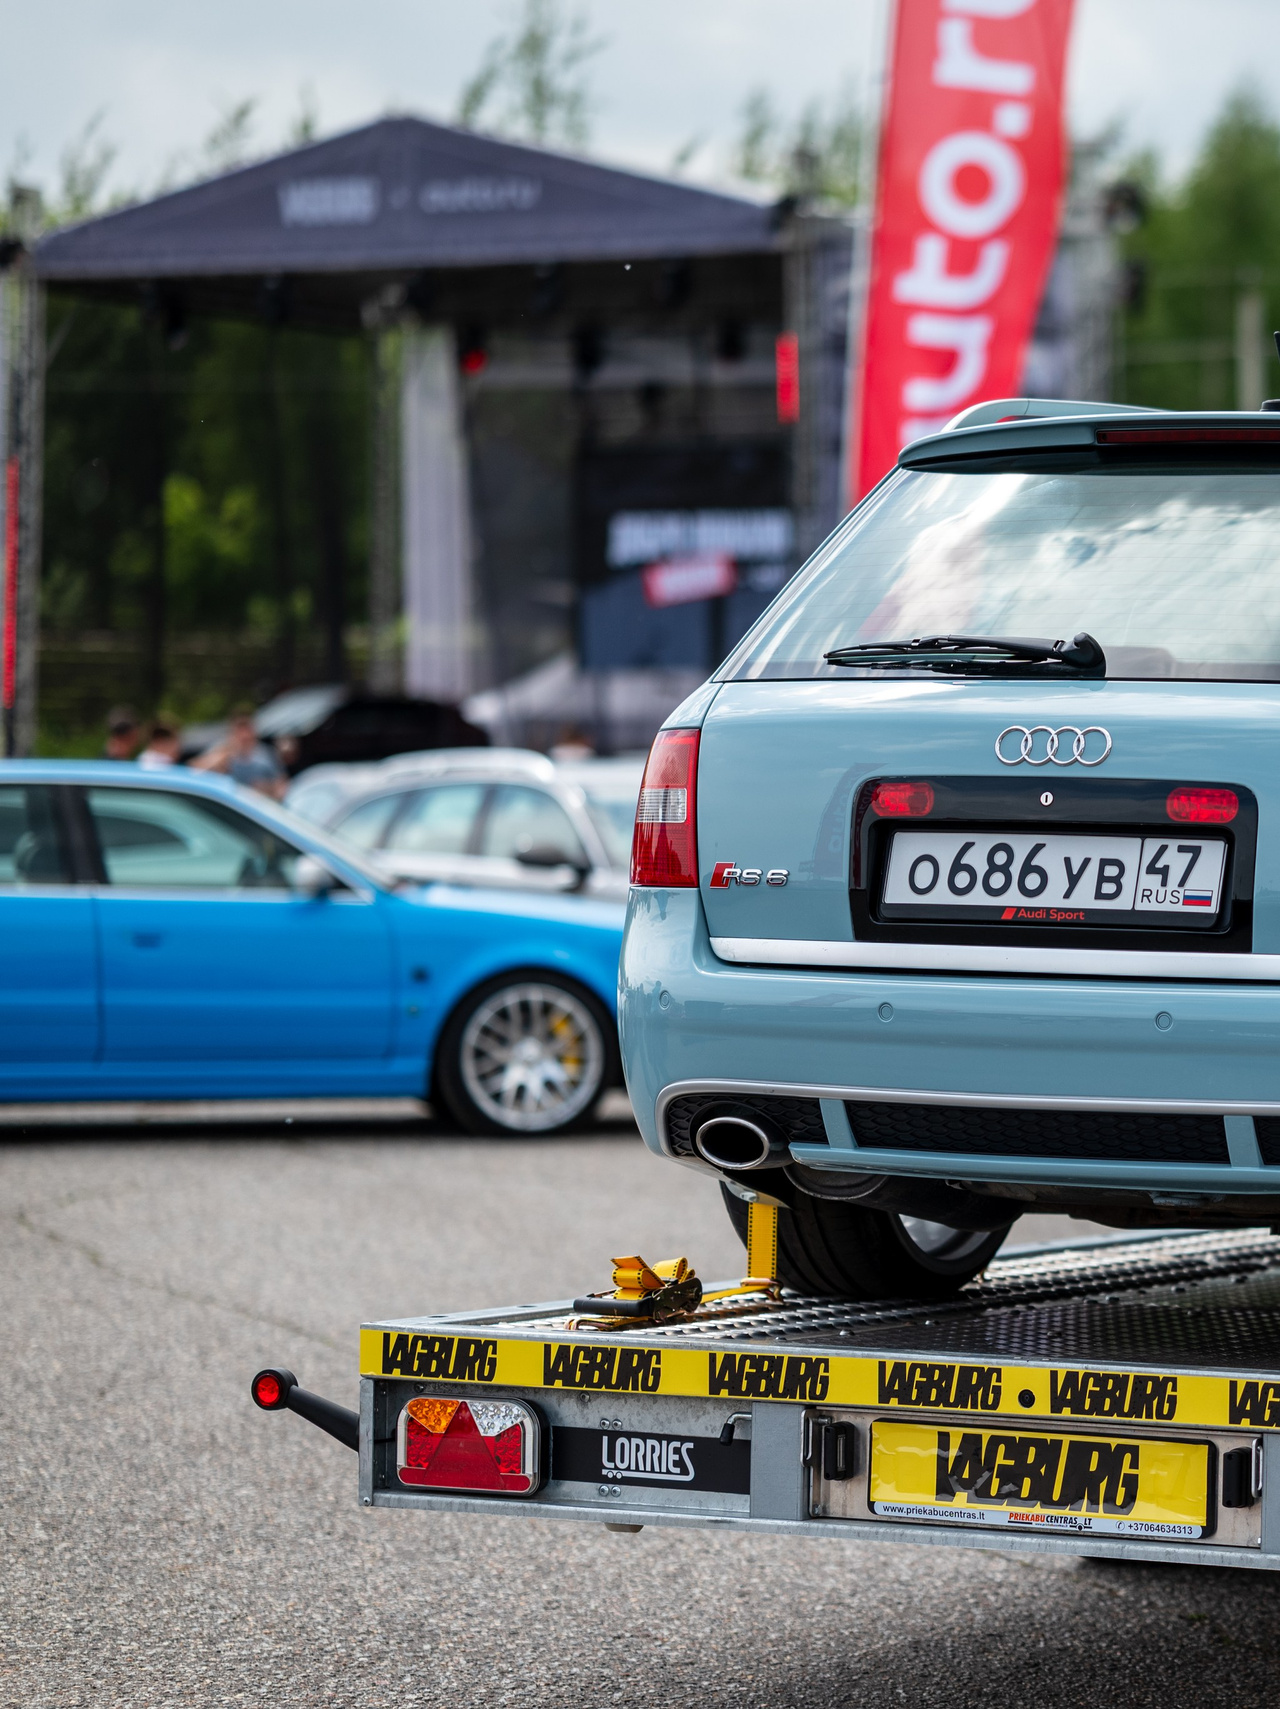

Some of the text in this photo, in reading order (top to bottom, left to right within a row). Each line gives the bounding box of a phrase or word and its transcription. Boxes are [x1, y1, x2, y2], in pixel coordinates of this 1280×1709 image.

[892, 0, 1037, 447] uto.r
[1145, 844, 1202, 887] 47
[1017, 908, 1085, 921] Audi Sport
[1140, 889, 1181, 905] RUS
[382, 1332, 498, 1381] VAGBURG
[543, 1343, 661, 1391] VAGBURG
[709, 1352, 830, 1401] VAGBURG
[878, 1360, 1001, 1410] VAGBURG
[1050, 1369, 1178, 1421] VAGBURG
[602, 1435, 695, 1481] LORRIES
[935, 1430, 1140, 1516] VAGBURG
[882, 1504, 985, 1521] www.priekabucentras.lt
[1127, 1522, 1193, 1535] +37064634313
